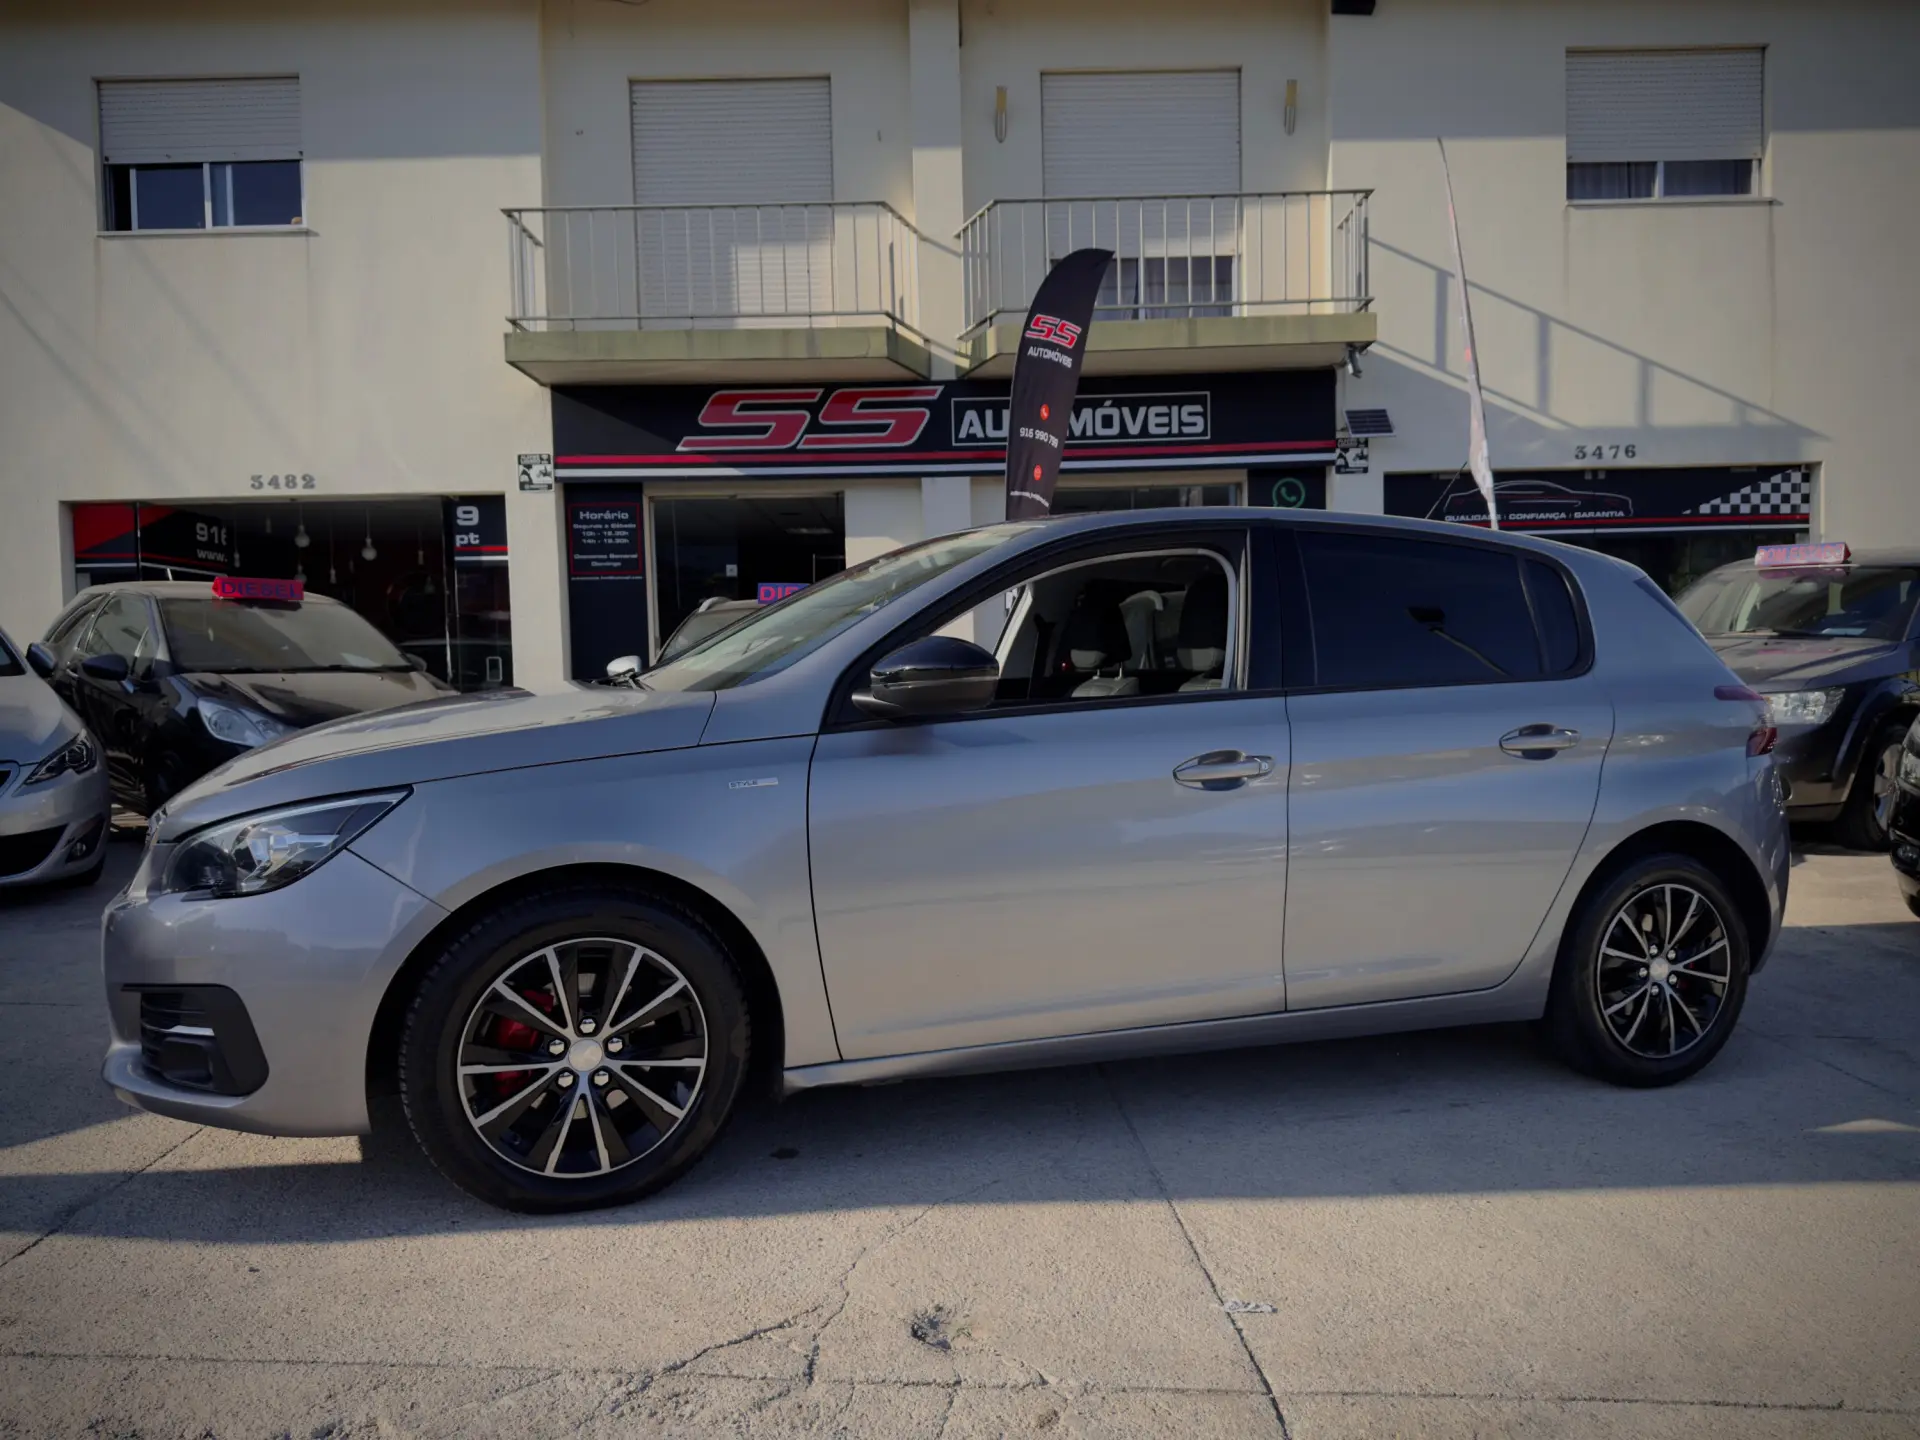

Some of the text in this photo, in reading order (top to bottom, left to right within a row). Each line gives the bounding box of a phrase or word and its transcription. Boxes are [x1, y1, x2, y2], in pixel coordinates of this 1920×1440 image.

[1024, 314, 1082, 349] SS
[1027, 346, 1073, 369] AUTOMÓVEIS
[675, 386, 945, 452] SS
[958, 400, 1205, 439] AUMÓVEIS
[1019, 427, 1034, 438] 916
[1574, 444, 1637, 460] 3476
[579, 510, 629, 520] Horário
[1508, 512, 1566, 520] CONFIANÇA
[1573, 510, 1625, 519] GARANTIA
[221, 581, 301, 599] DIESEL
